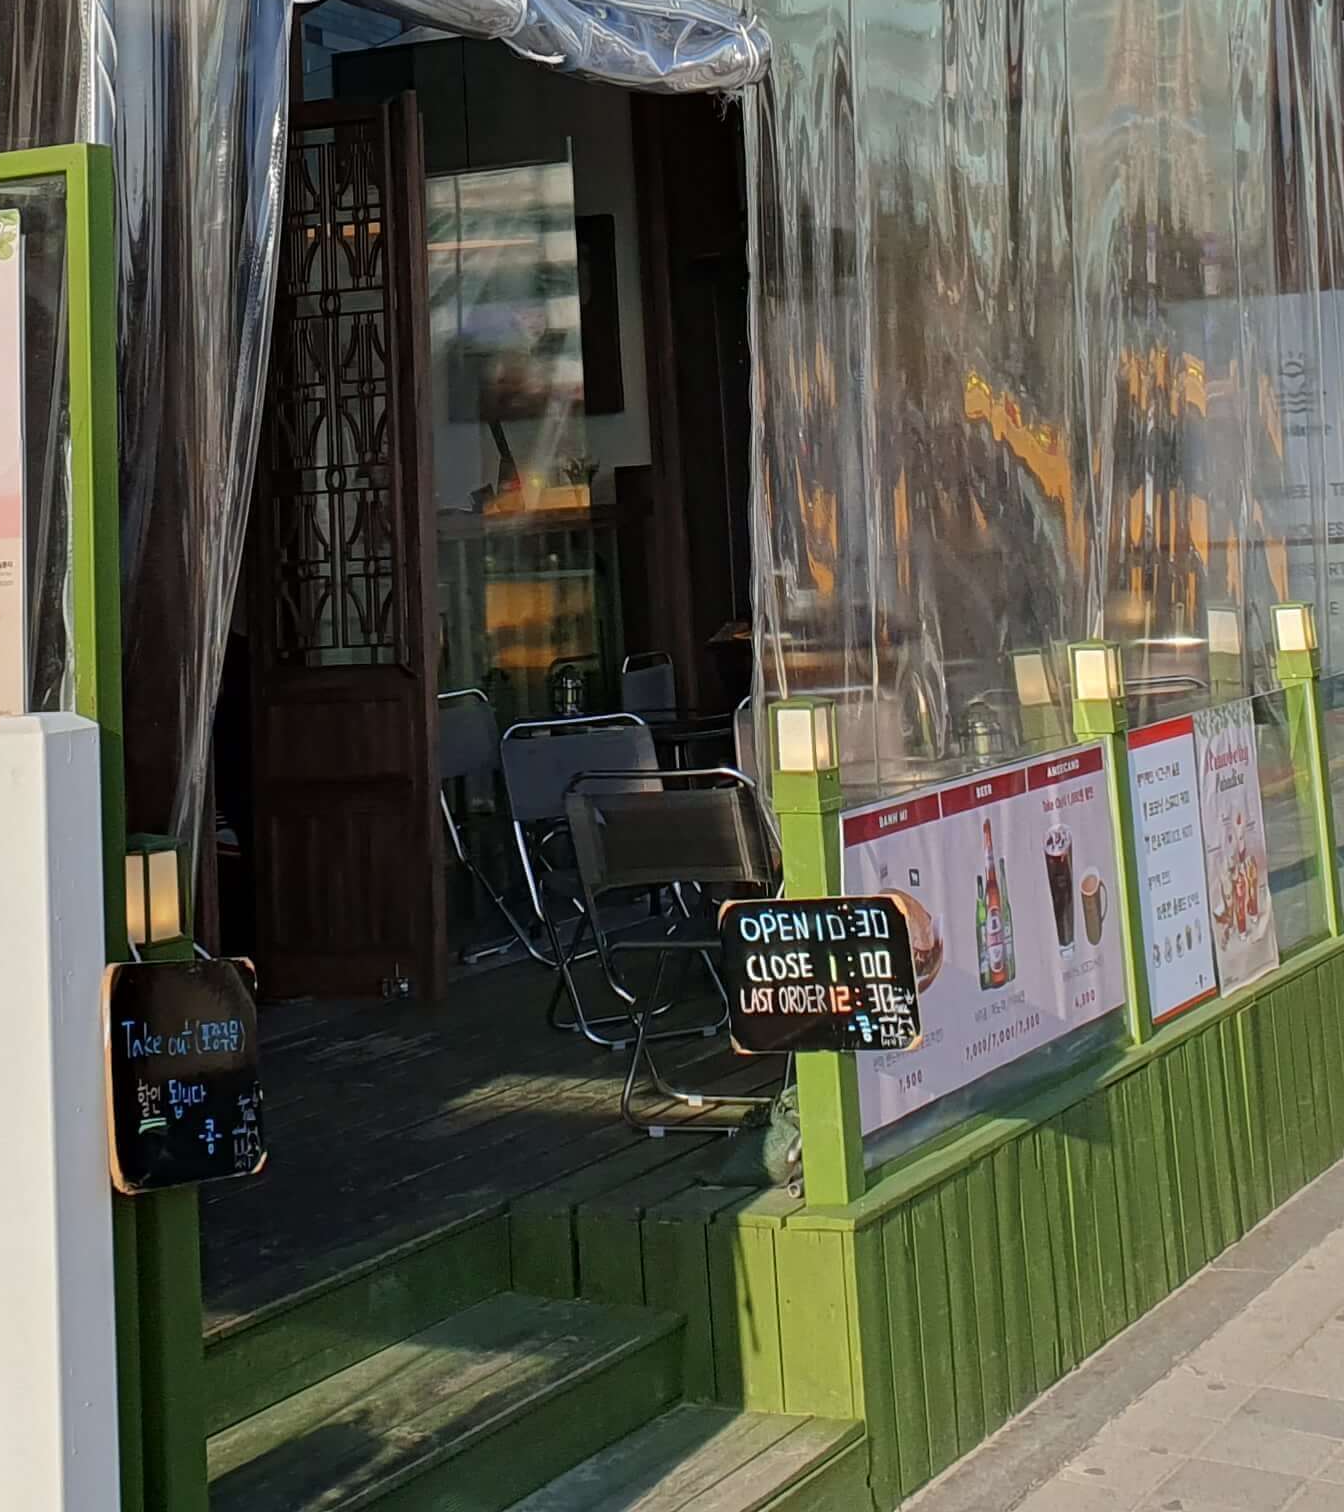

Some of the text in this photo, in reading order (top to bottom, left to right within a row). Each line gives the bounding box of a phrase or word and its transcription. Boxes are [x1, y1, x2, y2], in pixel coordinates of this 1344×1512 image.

[739, 910, 810, 944] OPEN
[746, 950, 892, 983] CLOSE 1:00
[740, 984, 895, 1014] LAST ORDER 12:30
[121, 1021, 163, 1059] Take
[137, 1079, 207, 1120] 할인 됩니다
